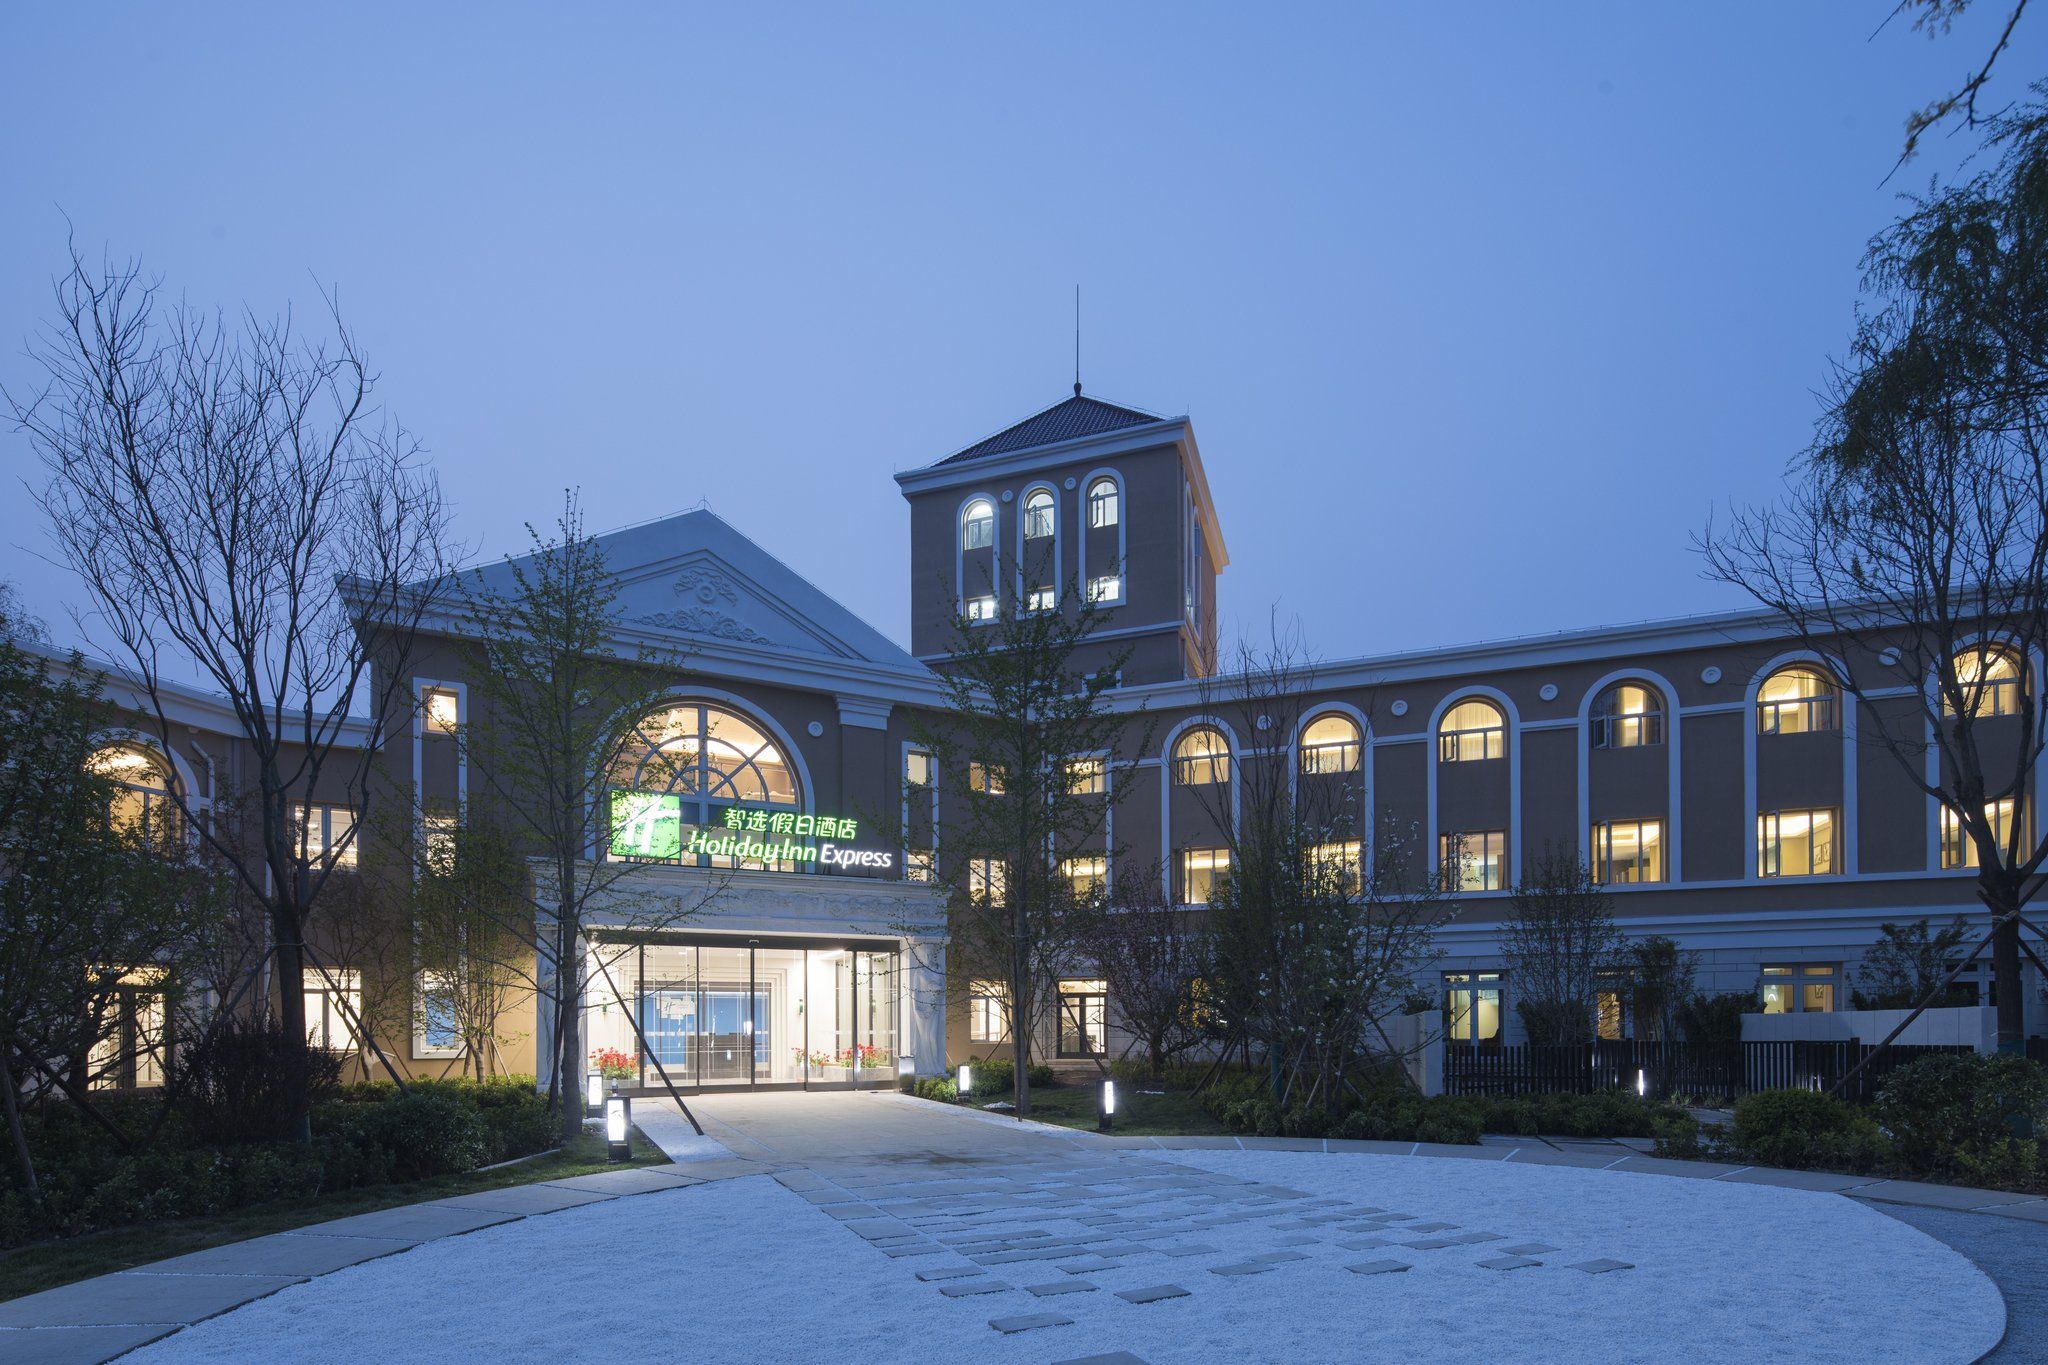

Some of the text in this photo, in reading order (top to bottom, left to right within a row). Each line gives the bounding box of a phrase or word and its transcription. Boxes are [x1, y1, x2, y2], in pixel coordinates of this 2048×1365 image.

[723, 807, 858, 839] 智选假日酒店
[820, 843, 892, 869] Express
